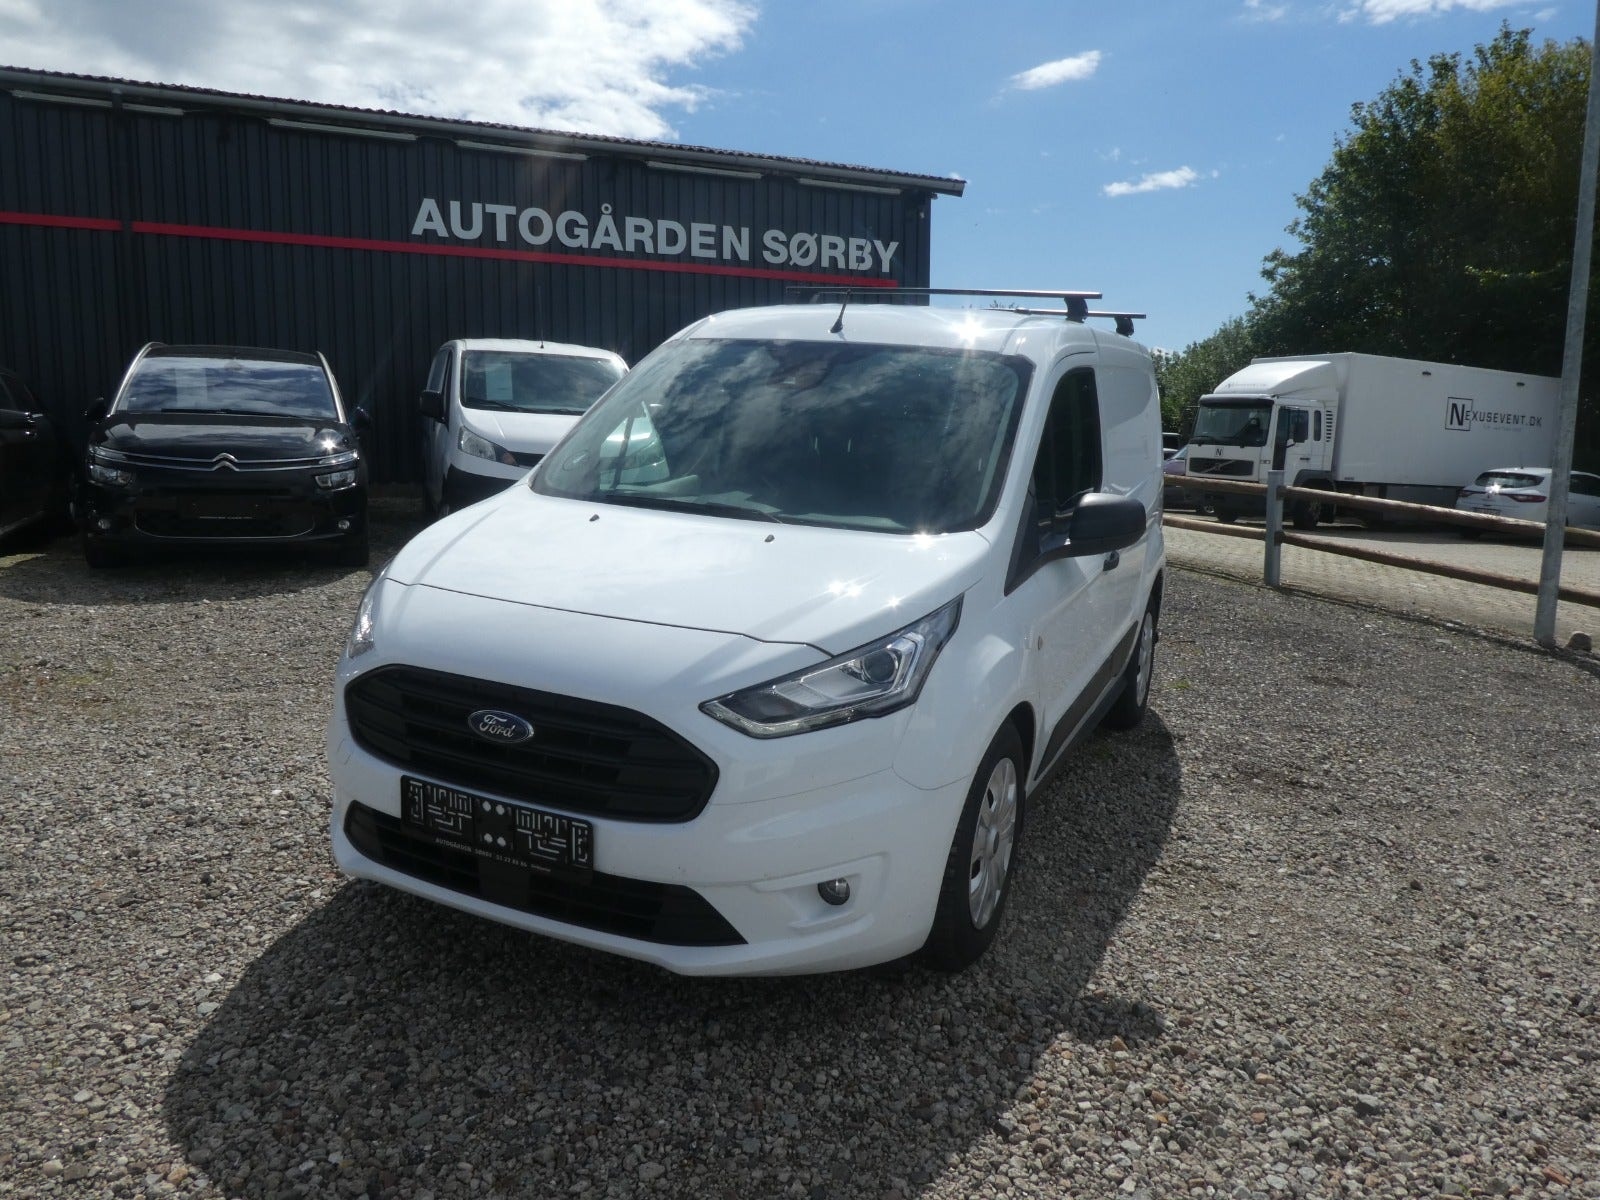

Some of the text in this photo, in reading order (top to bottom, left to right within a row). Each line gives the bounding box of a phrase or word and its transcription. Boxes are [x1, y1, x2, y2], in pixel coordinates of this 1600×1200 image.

[411, 197, 899, 273] AUTOGÅRDEN SØRBY
[1449, 402, 1542, 427] NEXUSEVENT.DK
[479, 714, 515, 738] Ford
